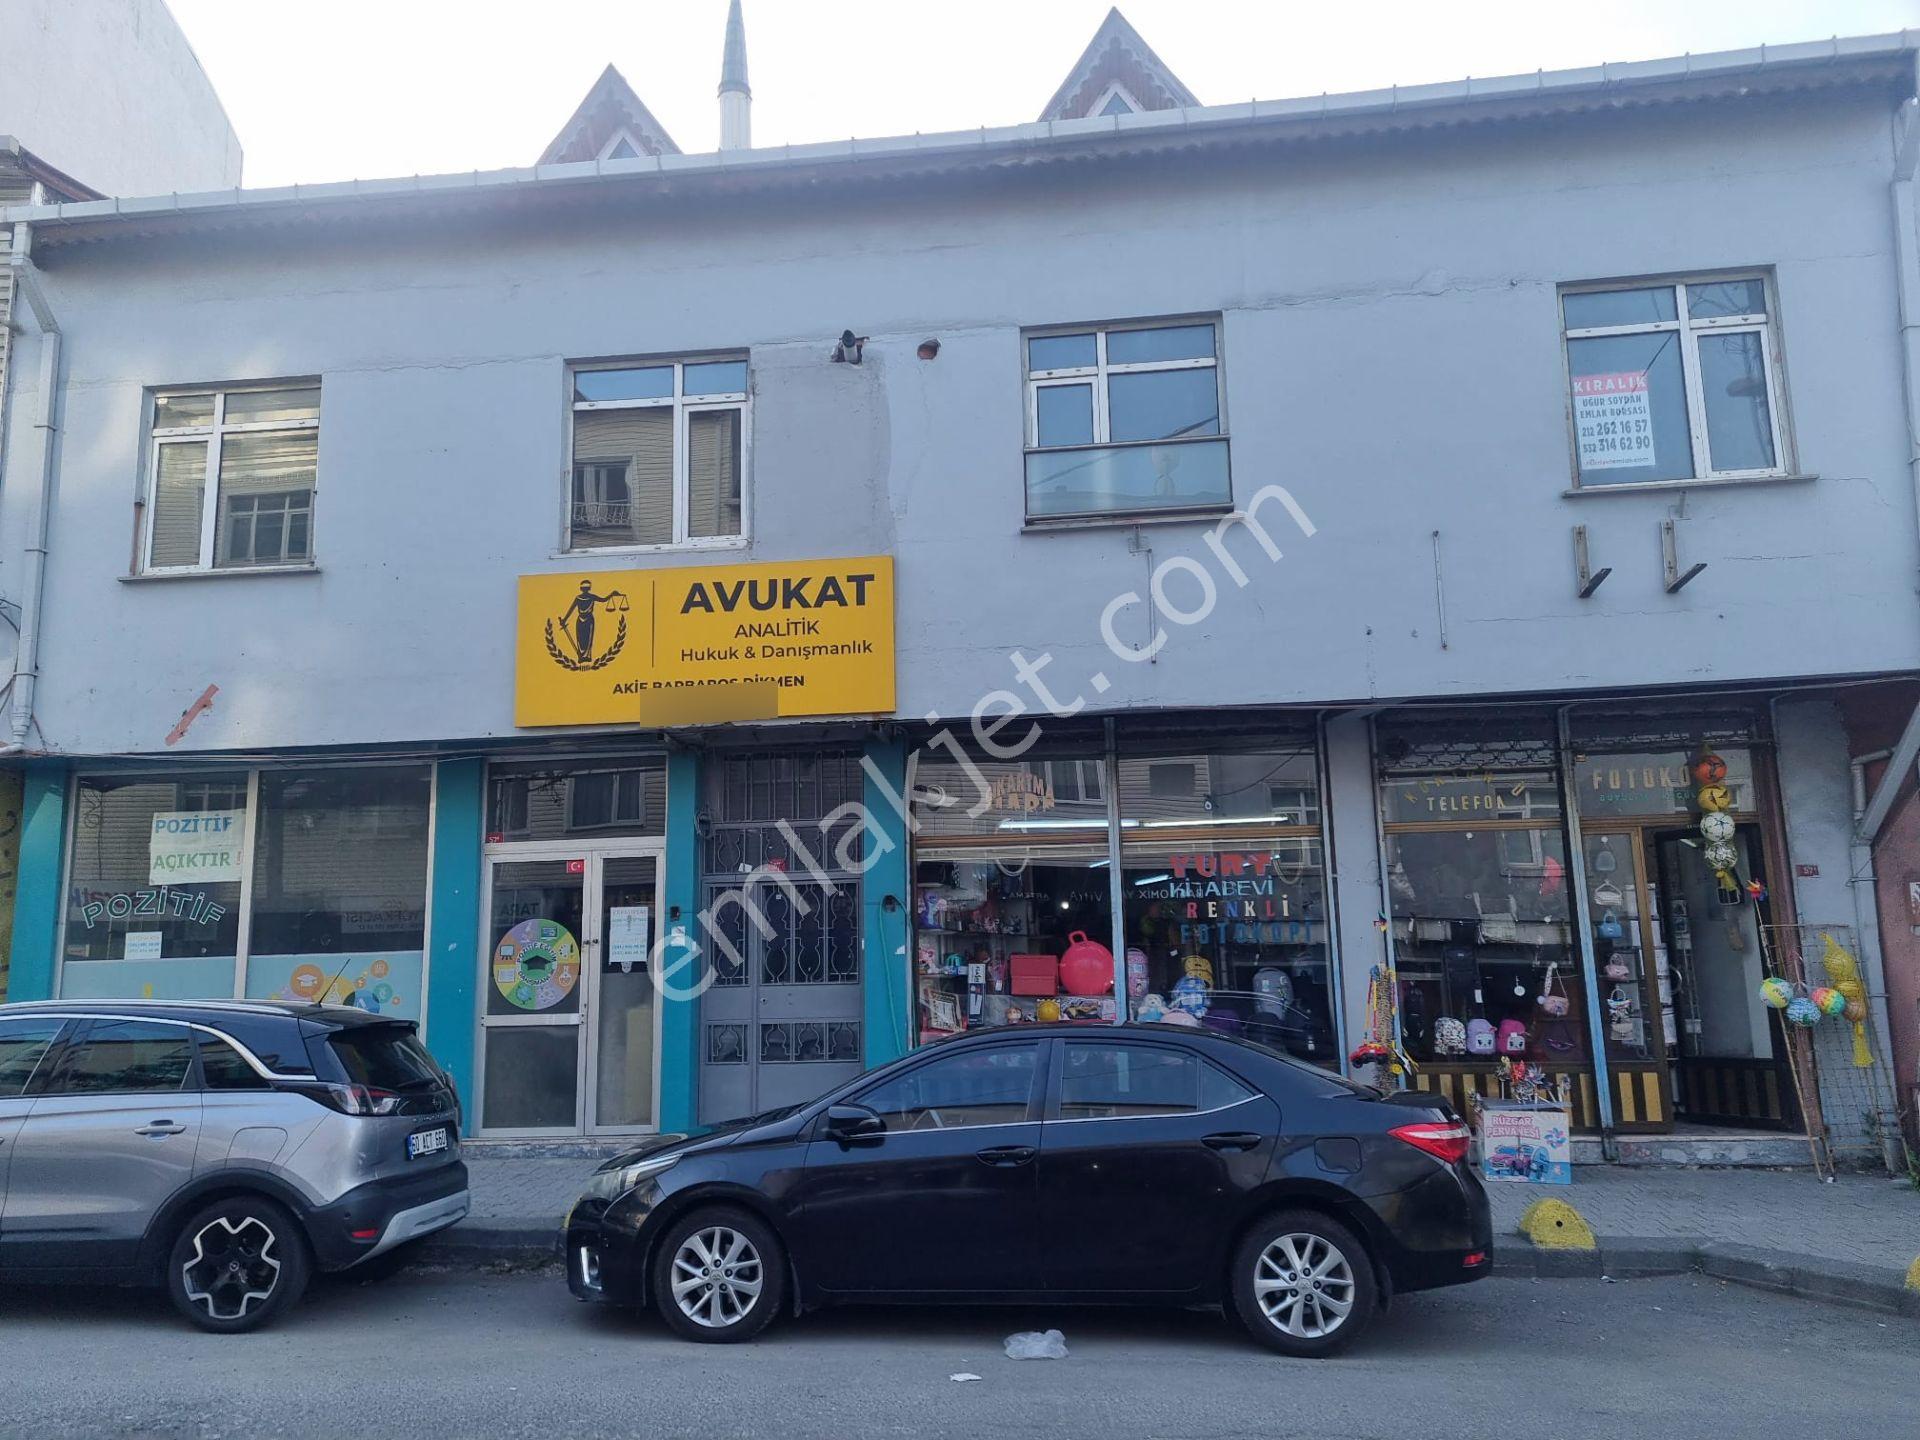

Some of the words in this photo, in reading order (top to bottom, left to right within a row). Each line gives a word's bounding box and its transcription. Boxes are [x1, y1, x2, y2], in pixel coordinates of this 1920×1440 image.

[1573, 377, 1648, 393] KIRALIK
[1608, 394, 1641, 406] SOYDAN
[1580, 408, 1608, 419] EMLAK
[1582, 426, 1595, 437] 212
[1597, 421, 1617, 436] 262
[1620, 420, 1632, 433] 16
[1635, 419, 1648, 432] 57
[1598, 438, 1617, 452] 314
[1620, 437, 1633, 451] 62
[1636, 436, 1650, 450] 90
[680, 574, 875, 614] AVUKAT
[734, 617, 820, 639] ANALİTİK
[681, 647, 739, 663] Hukuk
[745, 645, 756, 660] &
[761, 640, 873, 663] Danışmanlık
[1426, 794, 1506, 812] TELEFON
[154, 814, 233, 834] POZİTİF
[153, 851, 231, 873] AÇIKTIR
[1169, 875, 1274, 897] KİTABEVİ
[82, 886, 226, 929] POZİTİF
[1186, 893, 1290, 919] RENKLİ
[1180, 917, 1313, 945] FOTOKOPİ
